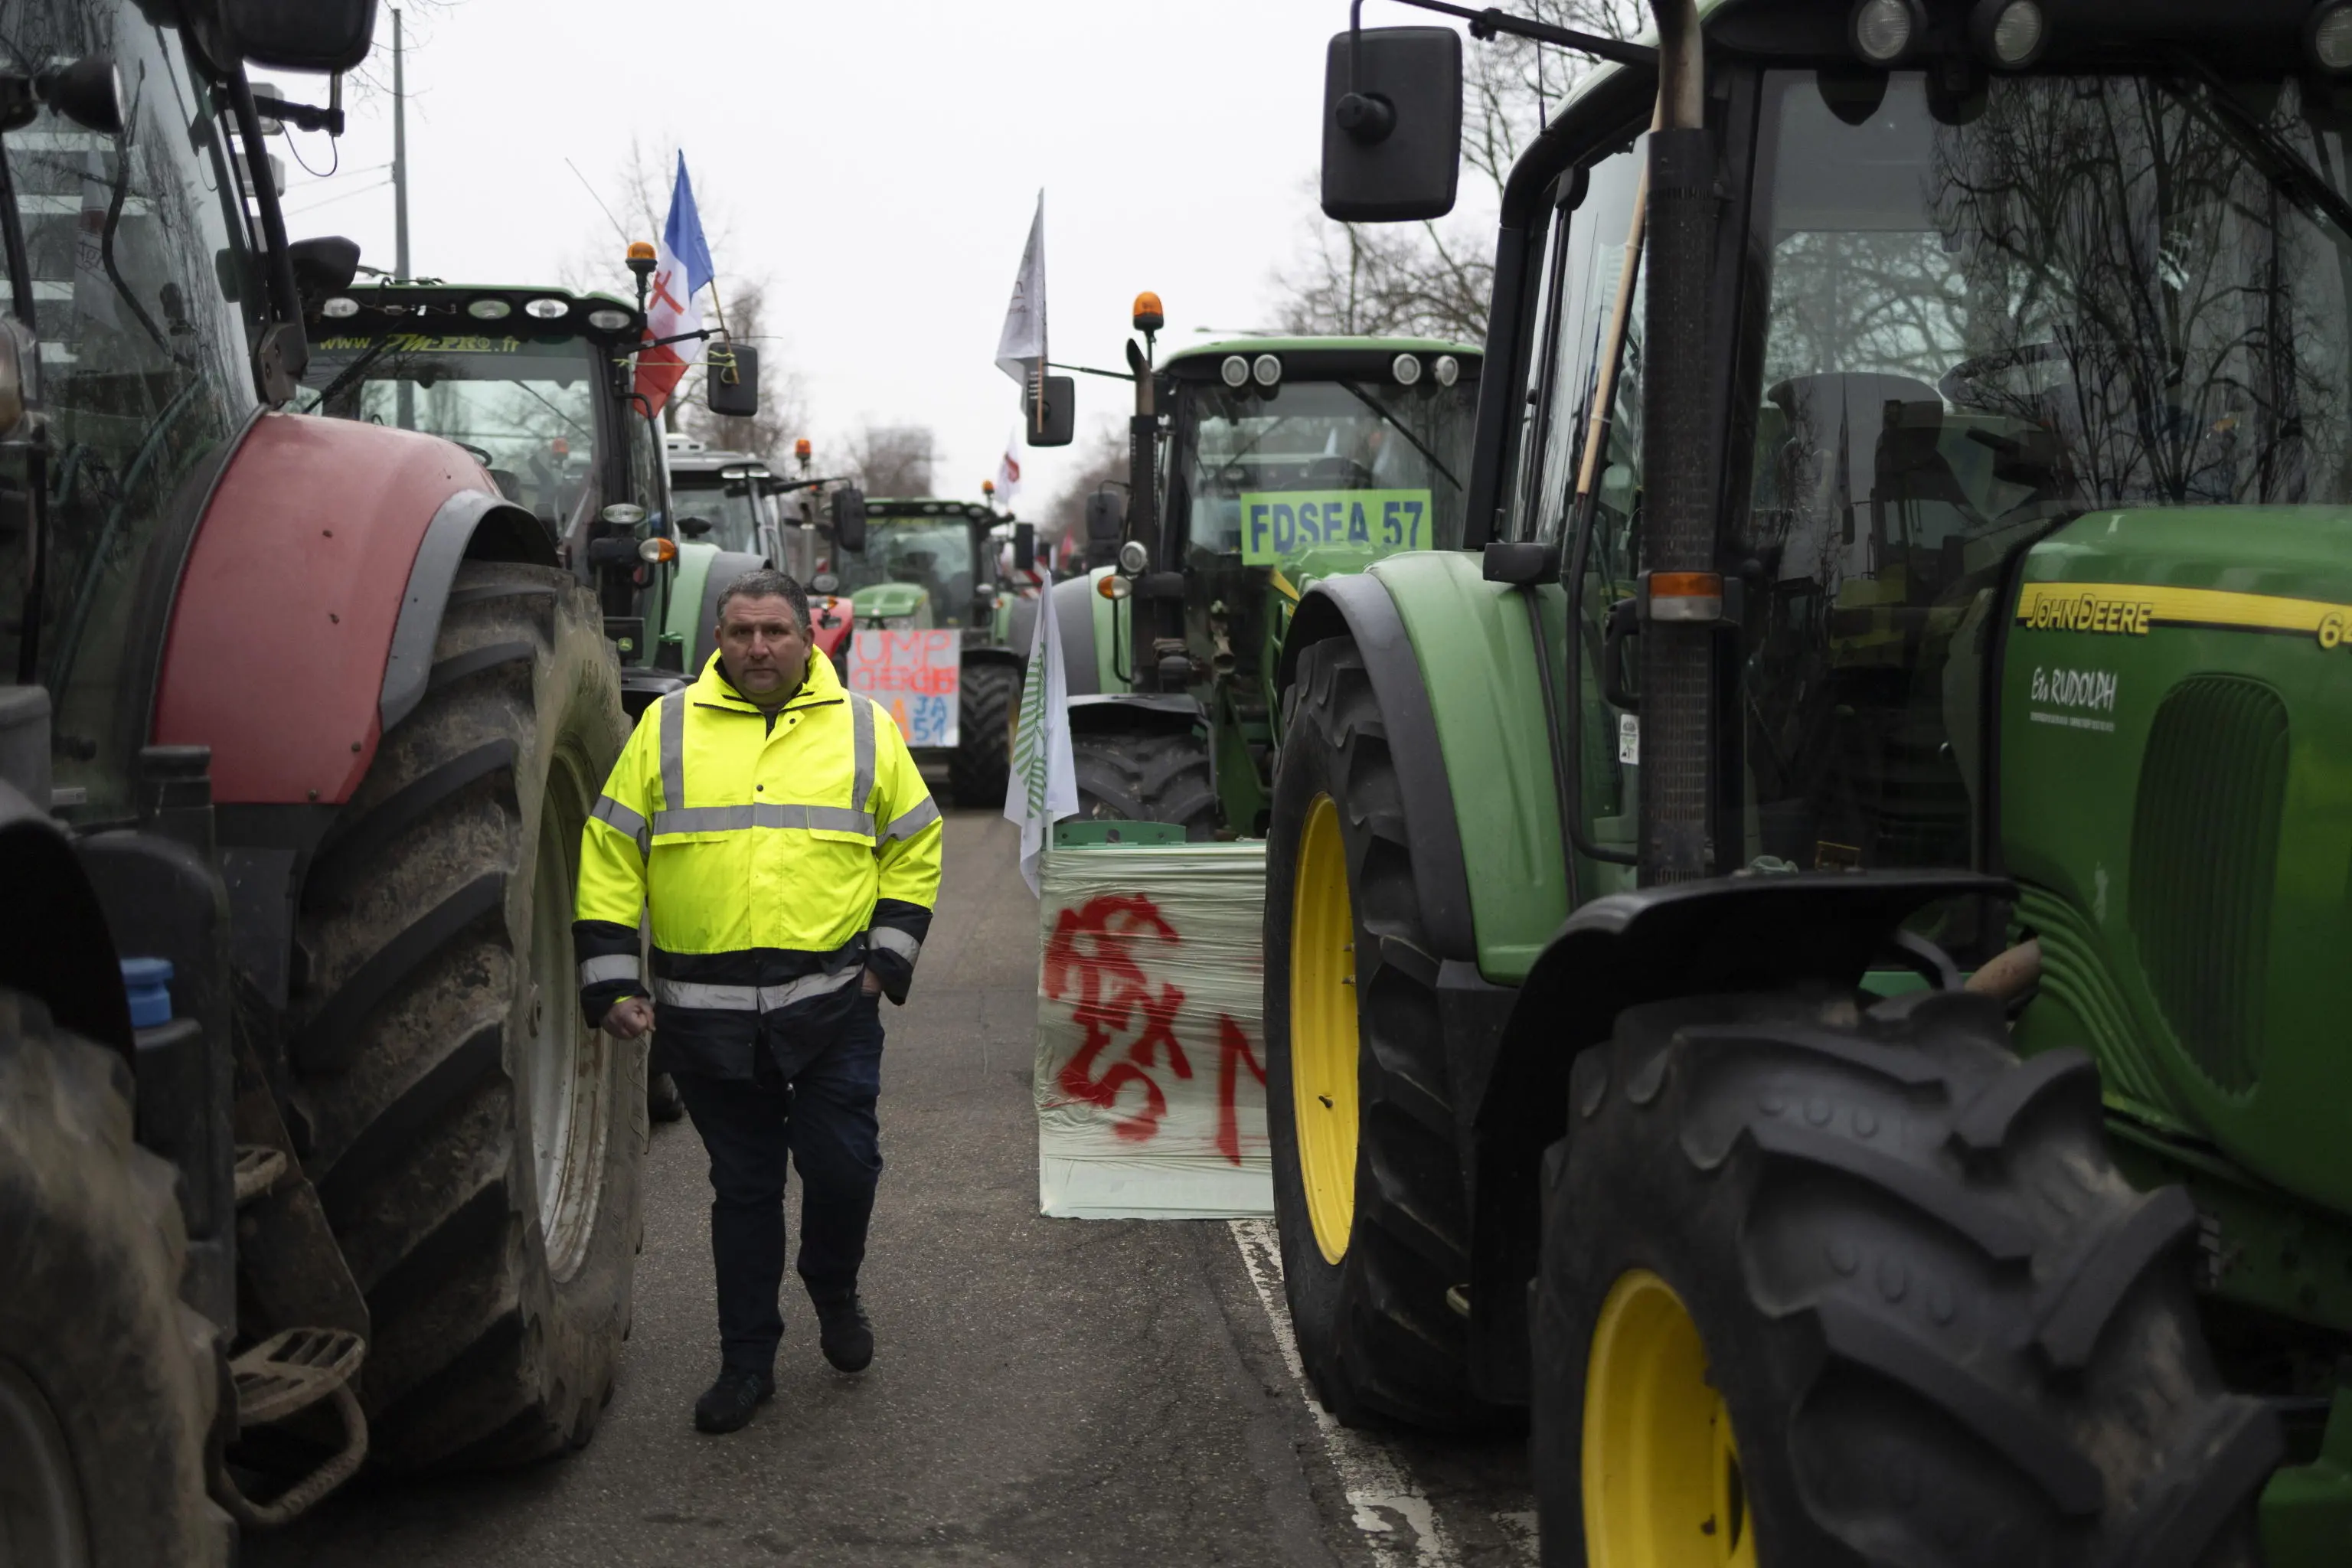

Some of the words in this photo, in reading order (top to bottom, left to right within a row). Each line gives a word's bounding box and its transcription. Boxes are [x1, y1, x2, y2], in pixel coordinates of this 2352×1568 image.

[1250, 501, 1370, 555] FDSEA
[1383, 501, 1423, 548] 57
[913, 694, 947, 718] JA
[2051, 668, 2118, 713] RUDOLPH
